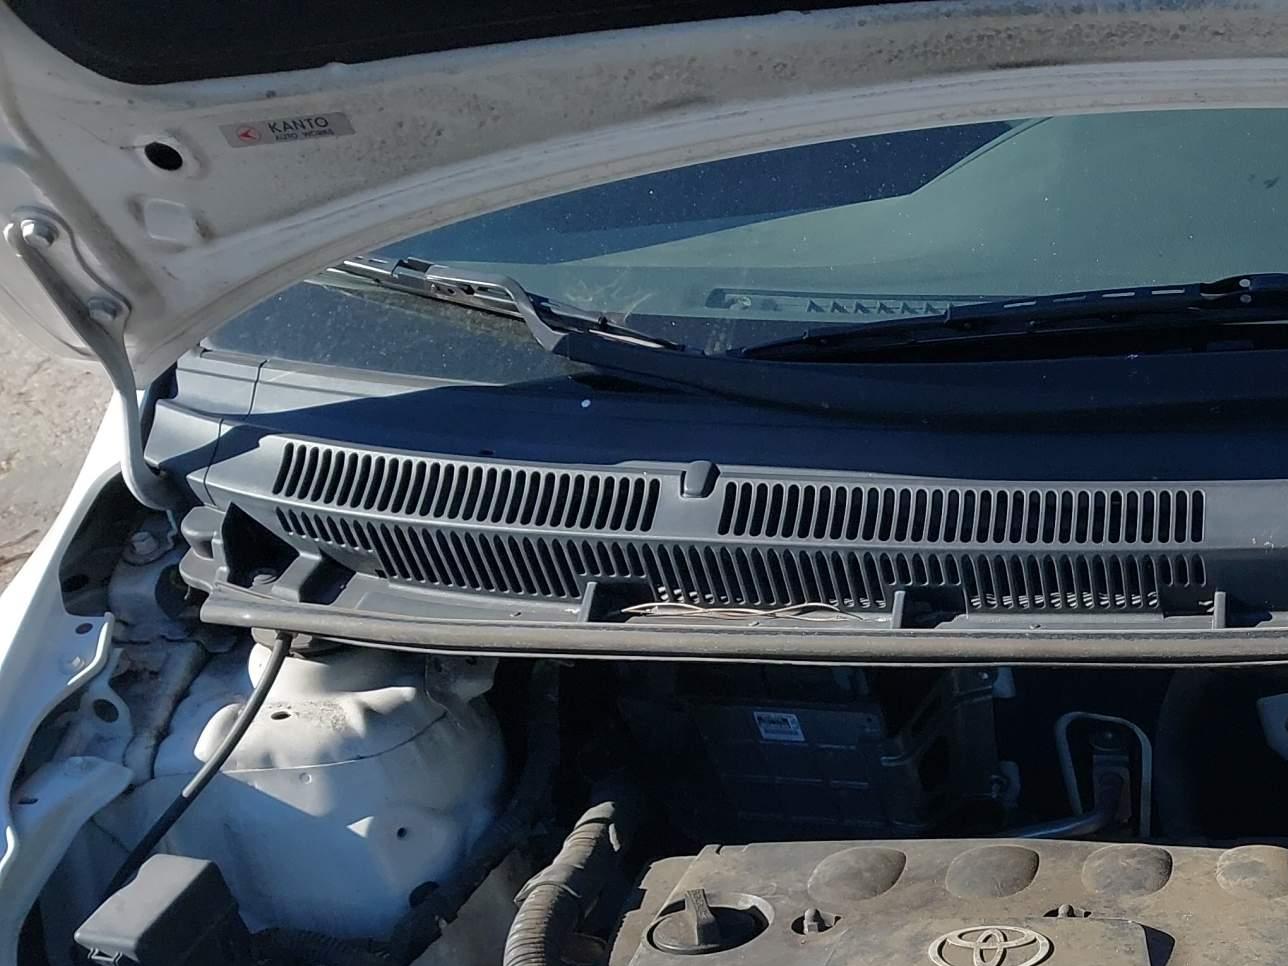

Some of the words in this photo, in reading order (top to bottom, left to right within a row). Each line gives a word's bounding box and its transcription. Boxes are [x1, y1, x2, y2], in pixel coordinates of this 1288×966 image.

[268, 116, 329, 134] KANTO
[275, 132, 298, 142] AUTO
[303, 128, 335, 138] WORKS
